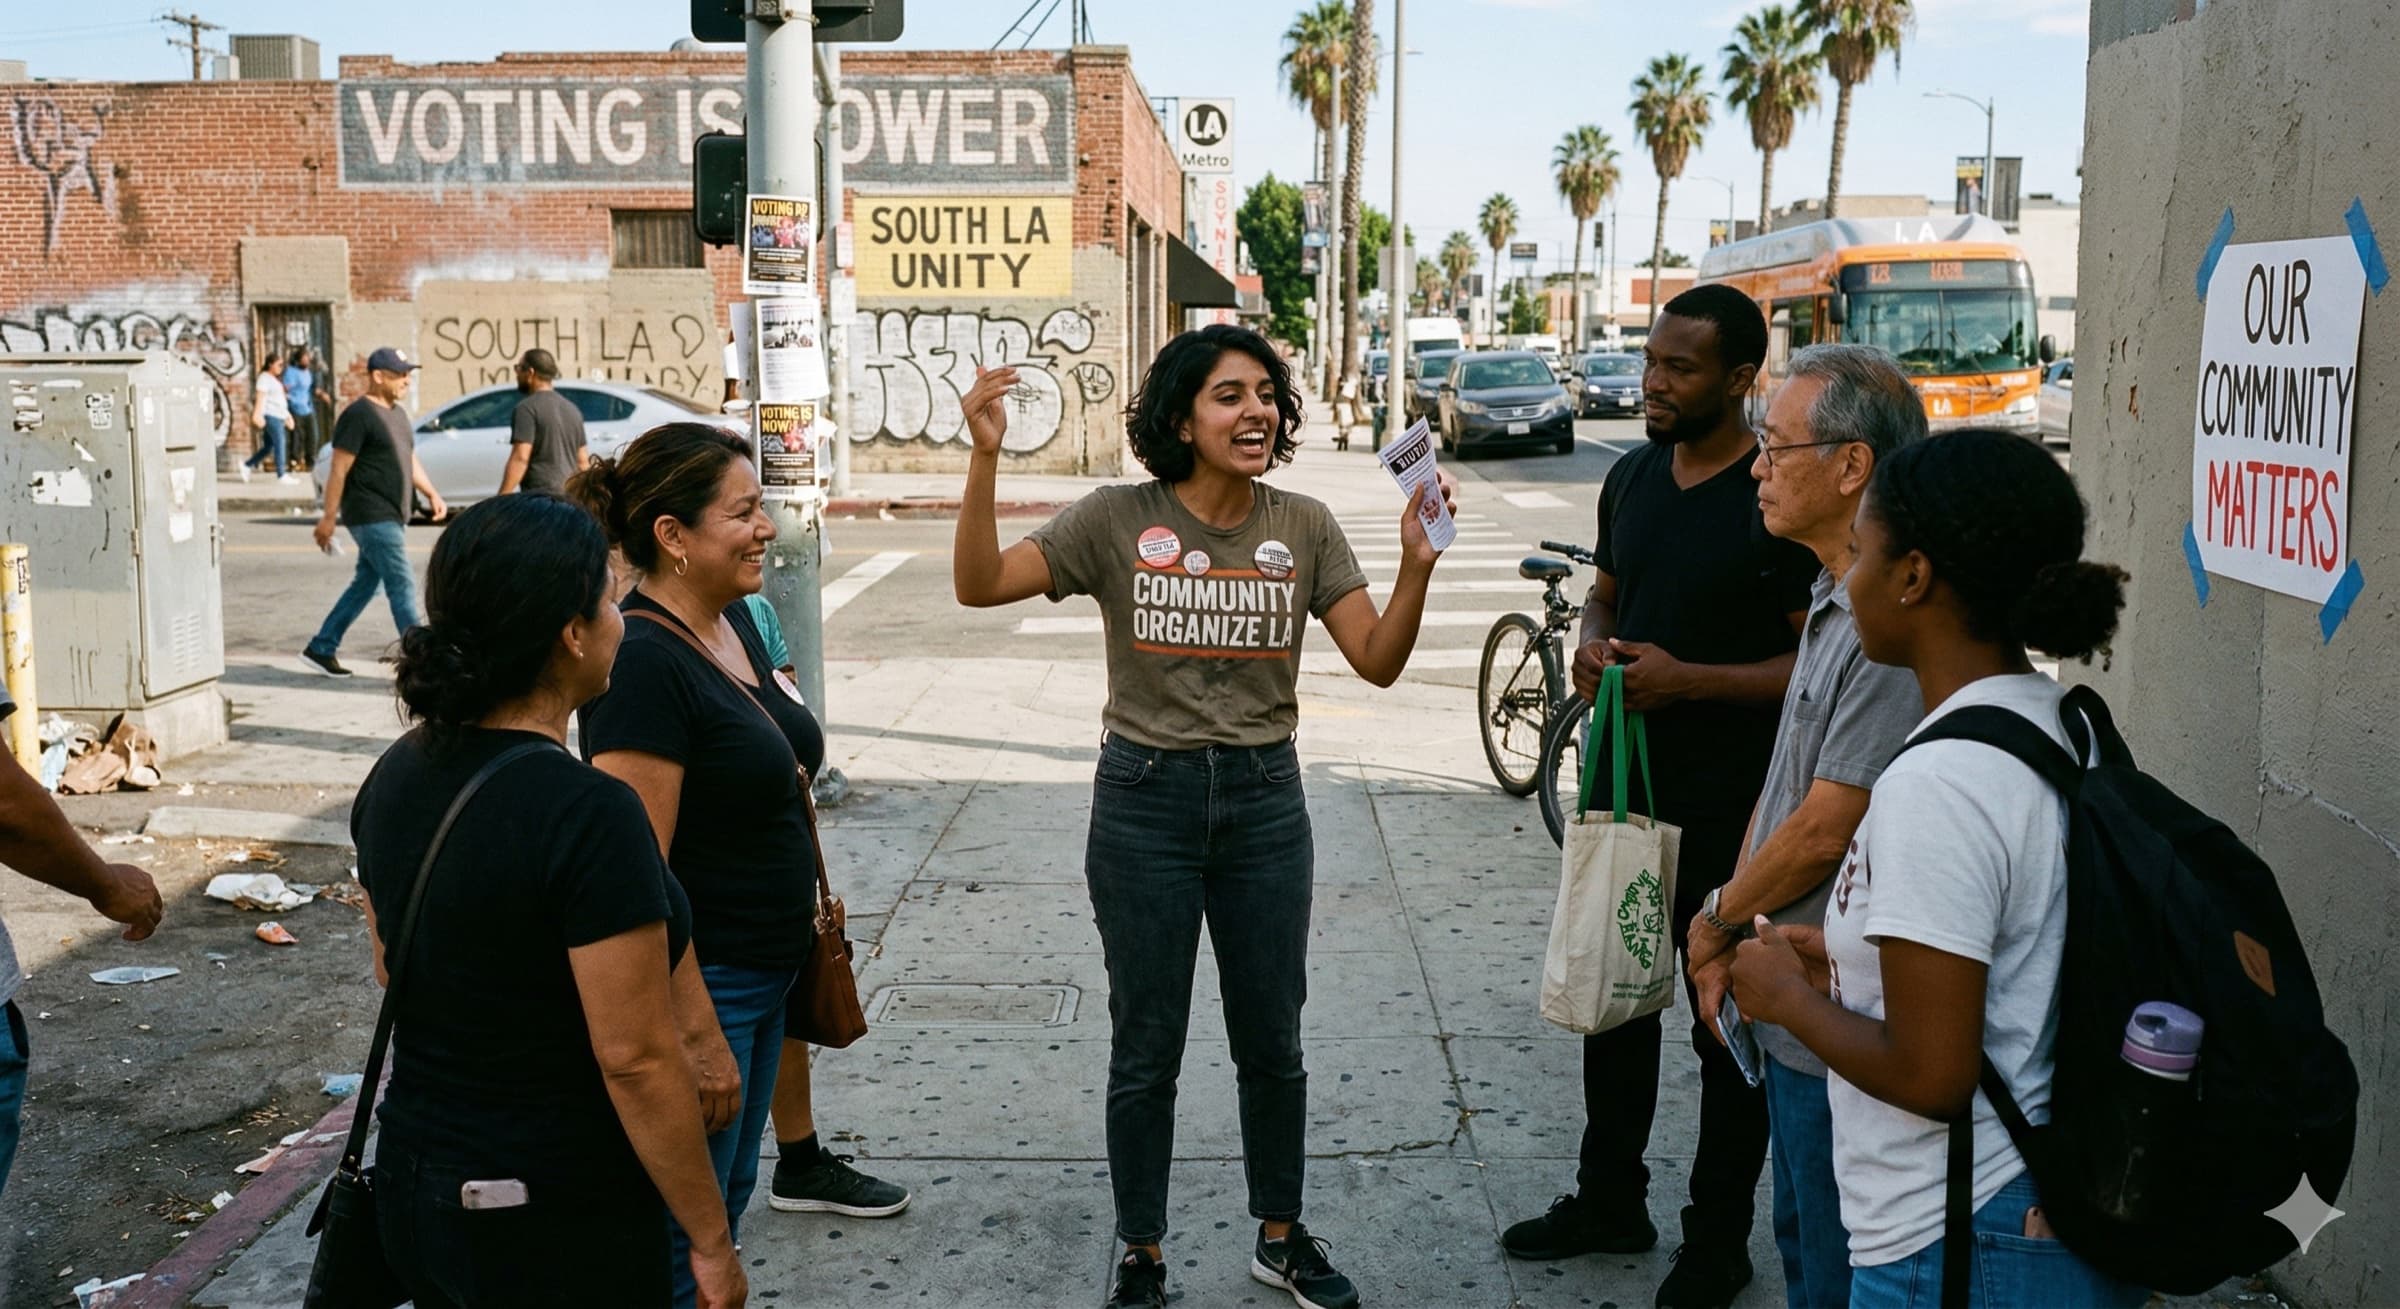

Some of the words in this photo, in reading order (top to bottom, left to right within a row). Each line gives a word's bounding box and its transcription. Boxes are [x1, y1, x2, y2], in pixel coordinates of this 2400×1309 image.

[356, 89, 647, 166] VOTING
[676, 87, 743, 164] IS
[812, 88, 1051, 165] OWER
[1189, 111, 1223, 139] LA
[1182, 153, 1230, 167] Metro
[752, 200, 794, 216] VOTING
[871, 206, 987, 245] SOUTH
[1003, 206, 1050, 244] LA
[1896, 222, 1937, 243] LA
[891, 253, 1031, 289] UNITY
[2244, 259, 2311, 345] OUR
[435, 317, 578, 362] SOUTH
[600, 316, 654, 362] LA
[801, 406, 812, 419] IS
[1933, 398, 1952, 416] LA
[2201, 360, 2354, 455] COMMUNITY
[2207, 460, 2339, 572] MATTERS
[1133, 571, 1296, 613] COMMUNITY
[1133, 608, 1261, 647] ORGANIZE
[1268, 617, 1293, 648] LA
